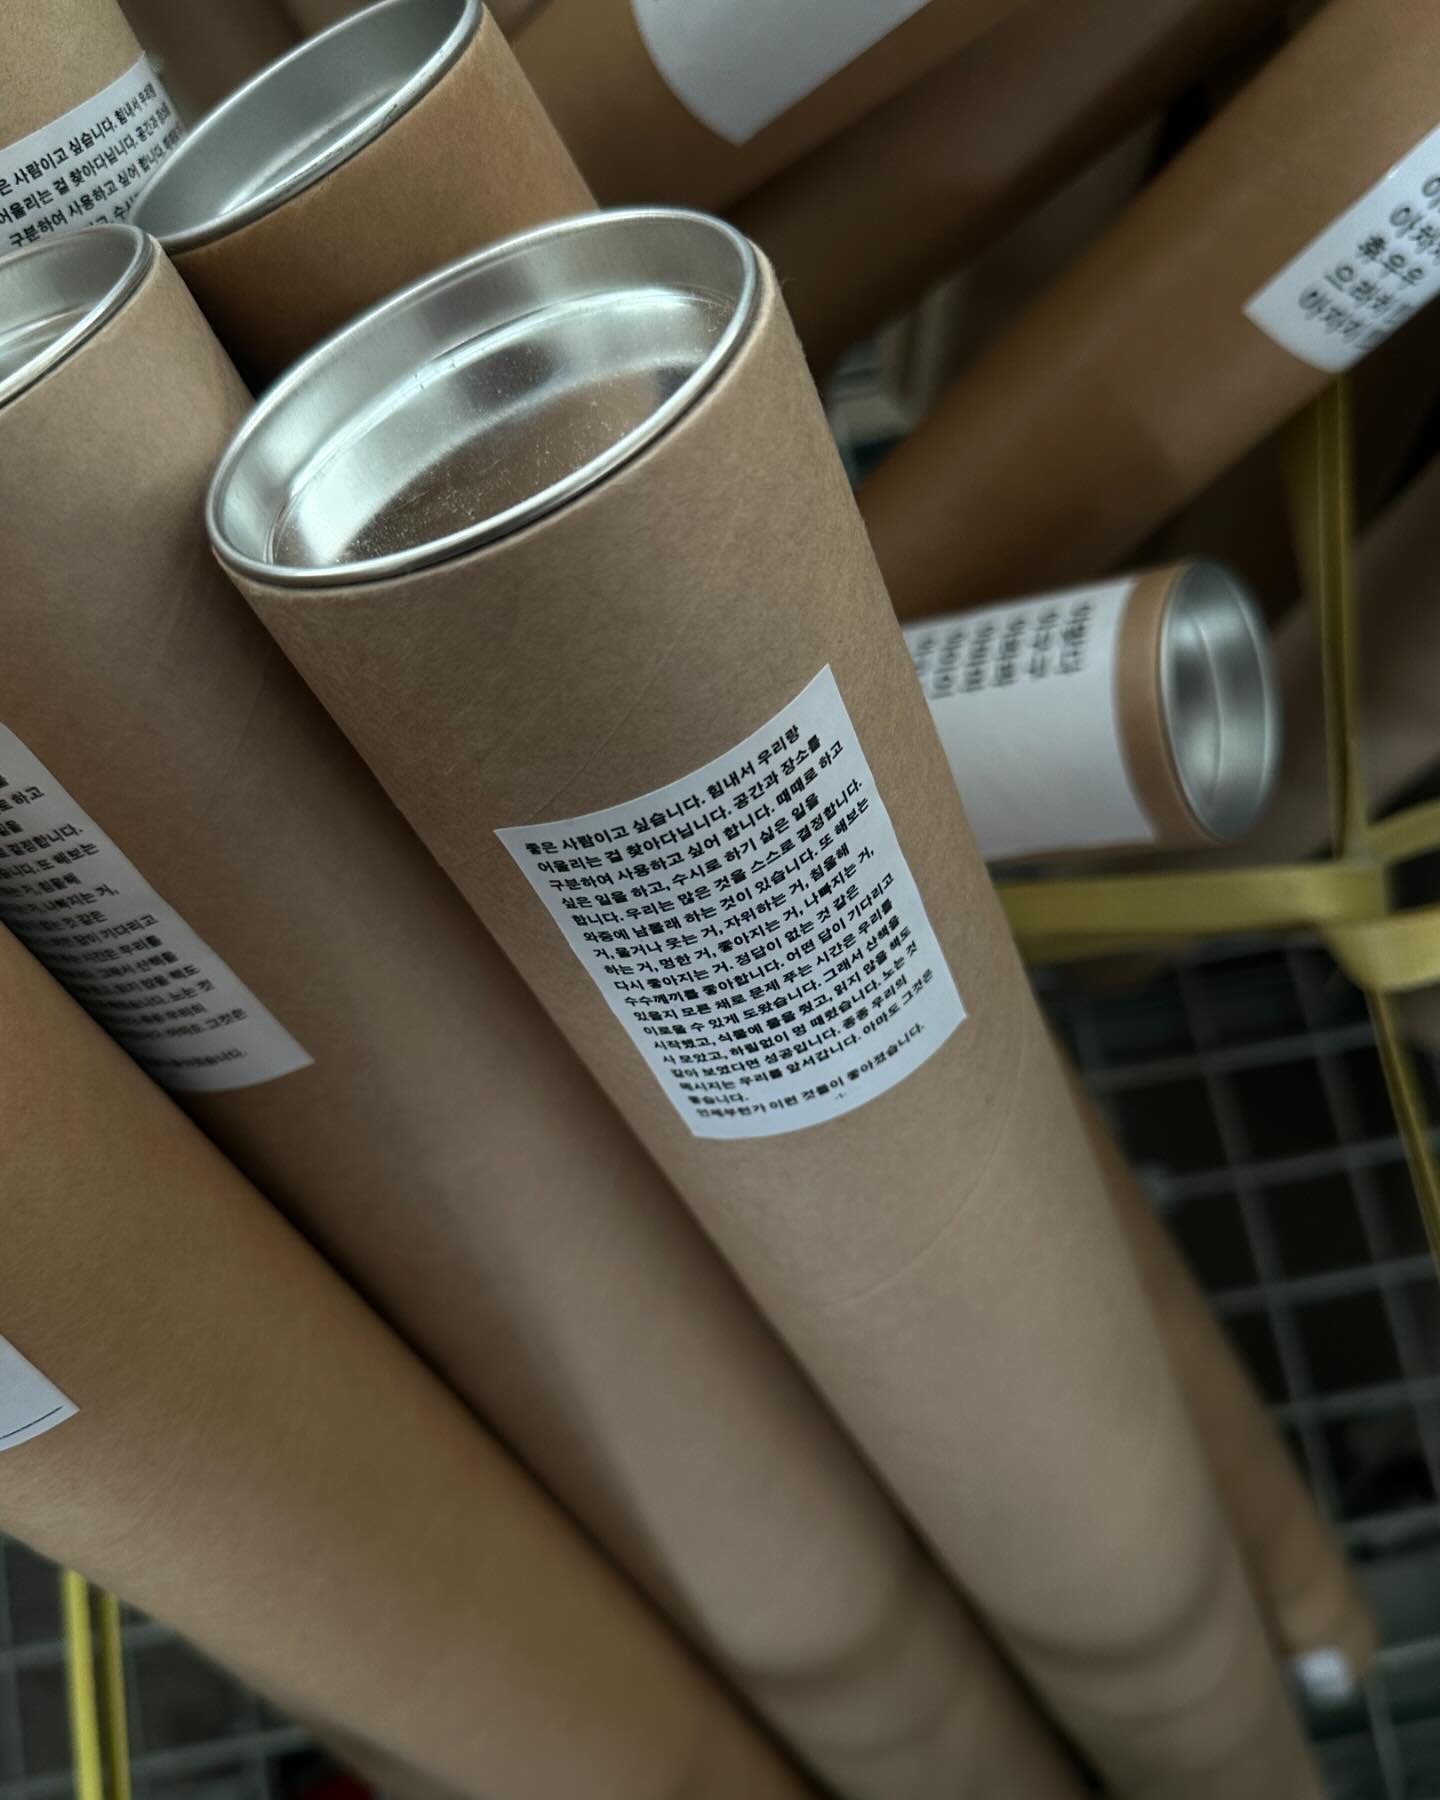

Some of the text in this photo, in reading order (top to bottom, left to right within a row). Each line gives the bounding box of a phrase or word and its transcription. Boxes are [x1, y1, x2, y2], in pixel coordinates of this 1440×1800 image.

[0, 187, 54, 225] 어울리는
[52, 176, 70, 196] 걸
[69, 134, 139, 187] 찾아다닙니다.
[8, 209, 68, 248] 구분하여
[69, 179, 119, 218] 사용하고
[117, 164, 140, 188] 싶어
[14, 147, 69, 185] 사람이고
[68, 116, 118, 156] 싶습니다.
[11, 786, 45, 805] 하고
[525, 724, 799, 854] 좋은 사람이고 싶습니다. 힘내서 우리랑
[537, 734, 820, 873] 어울리는 걸 찾아다닙니다. 공간과 장소를
[549, 740, 843, 891] 구분하여 사용하고 싶어 합니다. 때때로 하고
[562, 792, 819, 908] 싶은 일을 하고, 수시로 하기 싫은 일을
[571, 778, 862, 926] 합니다. 우리는 많은 것을 스스로 결정합니다.
[583, 928, 630, 942] 와중에
[683, 906, 717, 922] 하는
[719, 887, 752, 910] 것이
[754, 847, 818, 894] 있습니다.
[818, 832, 833, 851] 또
[833, 797, 868, 835] 해보는
[100, 914, 160, 940] 기다리고
[592, 947, 614, 959] 거,
[615, 940, 662, 958] 울거나
[665, 934, 698, 950] 웃는
[700, 924, 723, 937] 거,
[723, 892, 786, 928] 자위하는
[788, 878, 809, 894] 거,
[603, 846, 873, 975] 하는 거, 멍한 거, 좋아지는 거, 나빠지는 거,
[613, 884, 859, 991] 다시 좋아지는 거. 정답이 없는 것 같은
[624, 872, 893, 1006] 수수께끼를 좋아합니다. 어떤 답이 기다리고
[680, 1002, 711, 1016] 모른
[714, 993, 747, 1009] 채로
[748, 978, 780, 999] 문제
[816, 933, 856, 965] 시간은
[858, 897, 892, 934] 우리를
[663, 1054, 676, 1064] 사
[791, 1023, 807, 1036] 멍
[882, 956, 904, 981] 노는
[905, 940, 917, 957] 것
[690, 1022, 704, 1032] 수
[707, 1012, 740, 1029] 있게
[742, 979, 821, 1019] 도왔습니다.
[822, 947, 863, 982] 그래서
[717, 1022, 763, 1042] 식물에
[833, 970, 861, 996] 읽지
[862, 949, 887, 975] 않을
[889, 926, 910, 950] 책도
[739, 1067, 782, 1085] 우리를
[785, 1033, 861, 1073] 앞서갑니다.
[862, 1002, 900, 1034] 아마도
[901, 968, 932, 1005] 그것은
[764, 1026, 840, 1064] 성공입니다.
[871, 973, 907, 1008] 우리의
[769, 1095, 797, 1108] 이런
